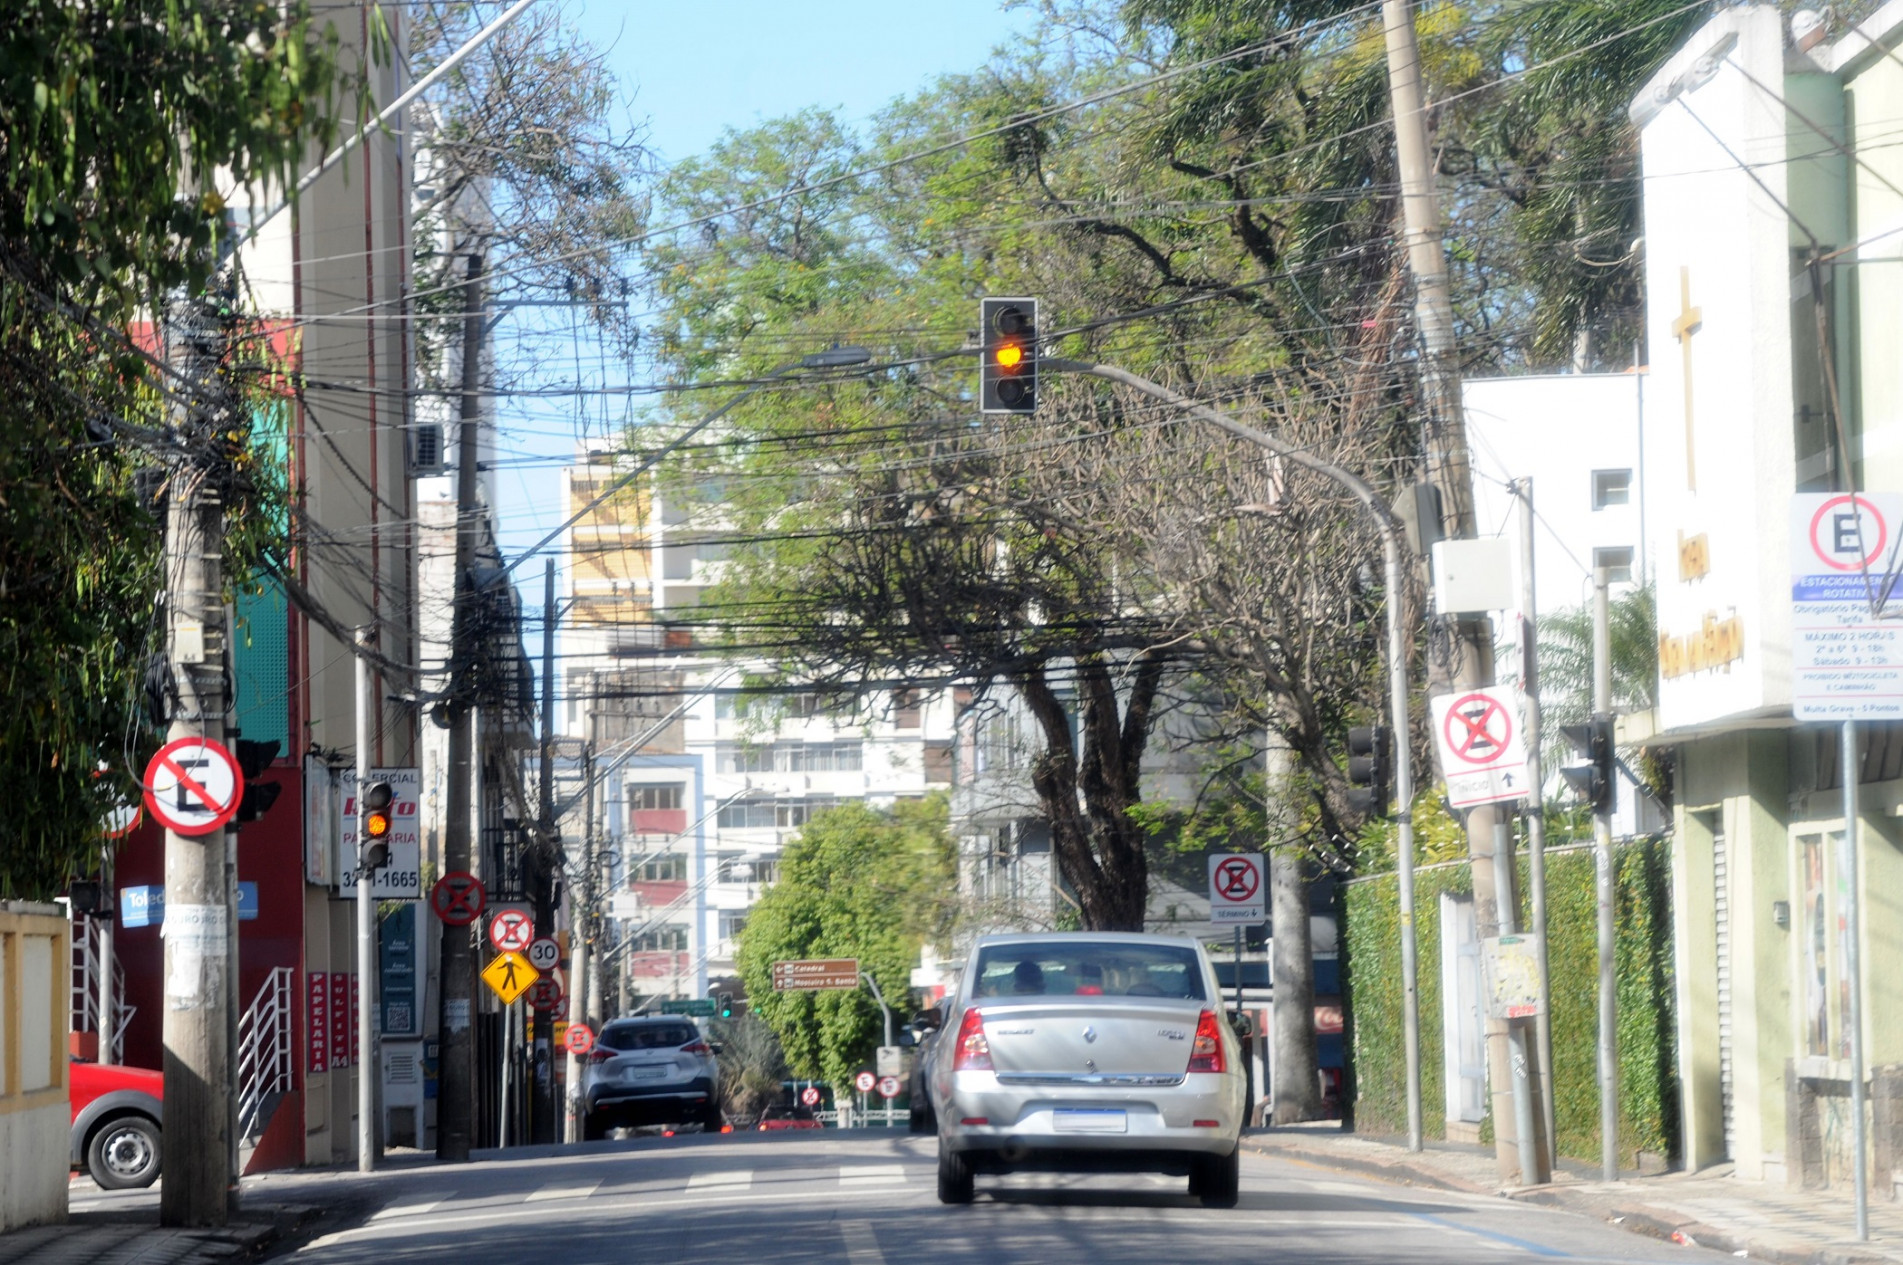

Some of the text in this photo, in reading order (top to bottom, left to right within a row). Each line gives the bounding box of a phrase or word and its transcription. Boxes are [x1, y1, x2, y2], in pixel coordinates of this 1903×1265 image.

[533, 944, 556, 961] 30
[312, 974, 325, 1071] PAPELARIA
[334, 975, 345, 1053] SULFITE
[332, 1055, 348, 1067] A4
